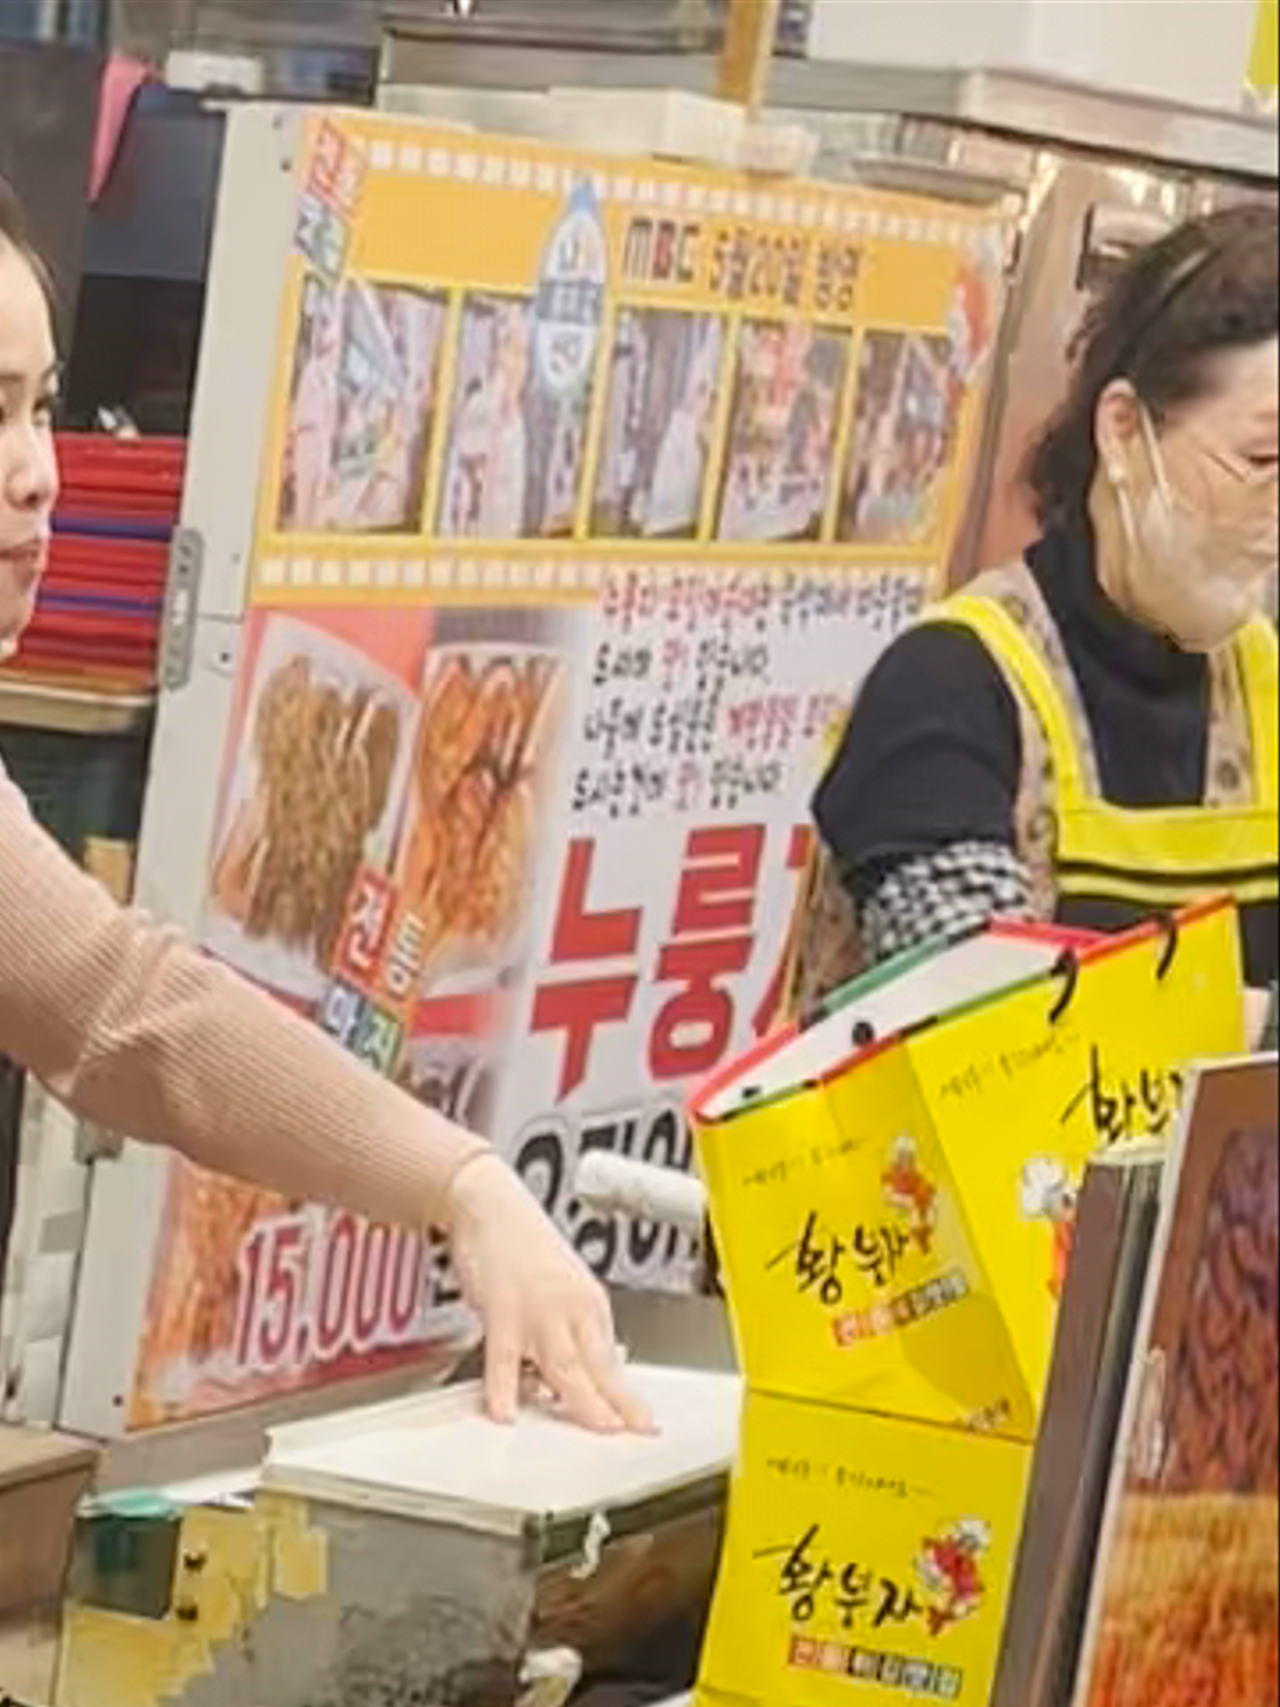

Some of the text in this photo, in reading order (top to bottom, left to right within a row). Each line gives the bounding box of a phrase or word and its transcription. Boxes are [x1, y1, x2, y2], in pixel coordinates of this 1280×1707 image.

[623, 216, 700, 285] MBC
[1060, 1043, 1184, 1143] 황부
[765, 1209, 909, 1306] 황부자
[751, 1522, 924, 1629] 황부자
